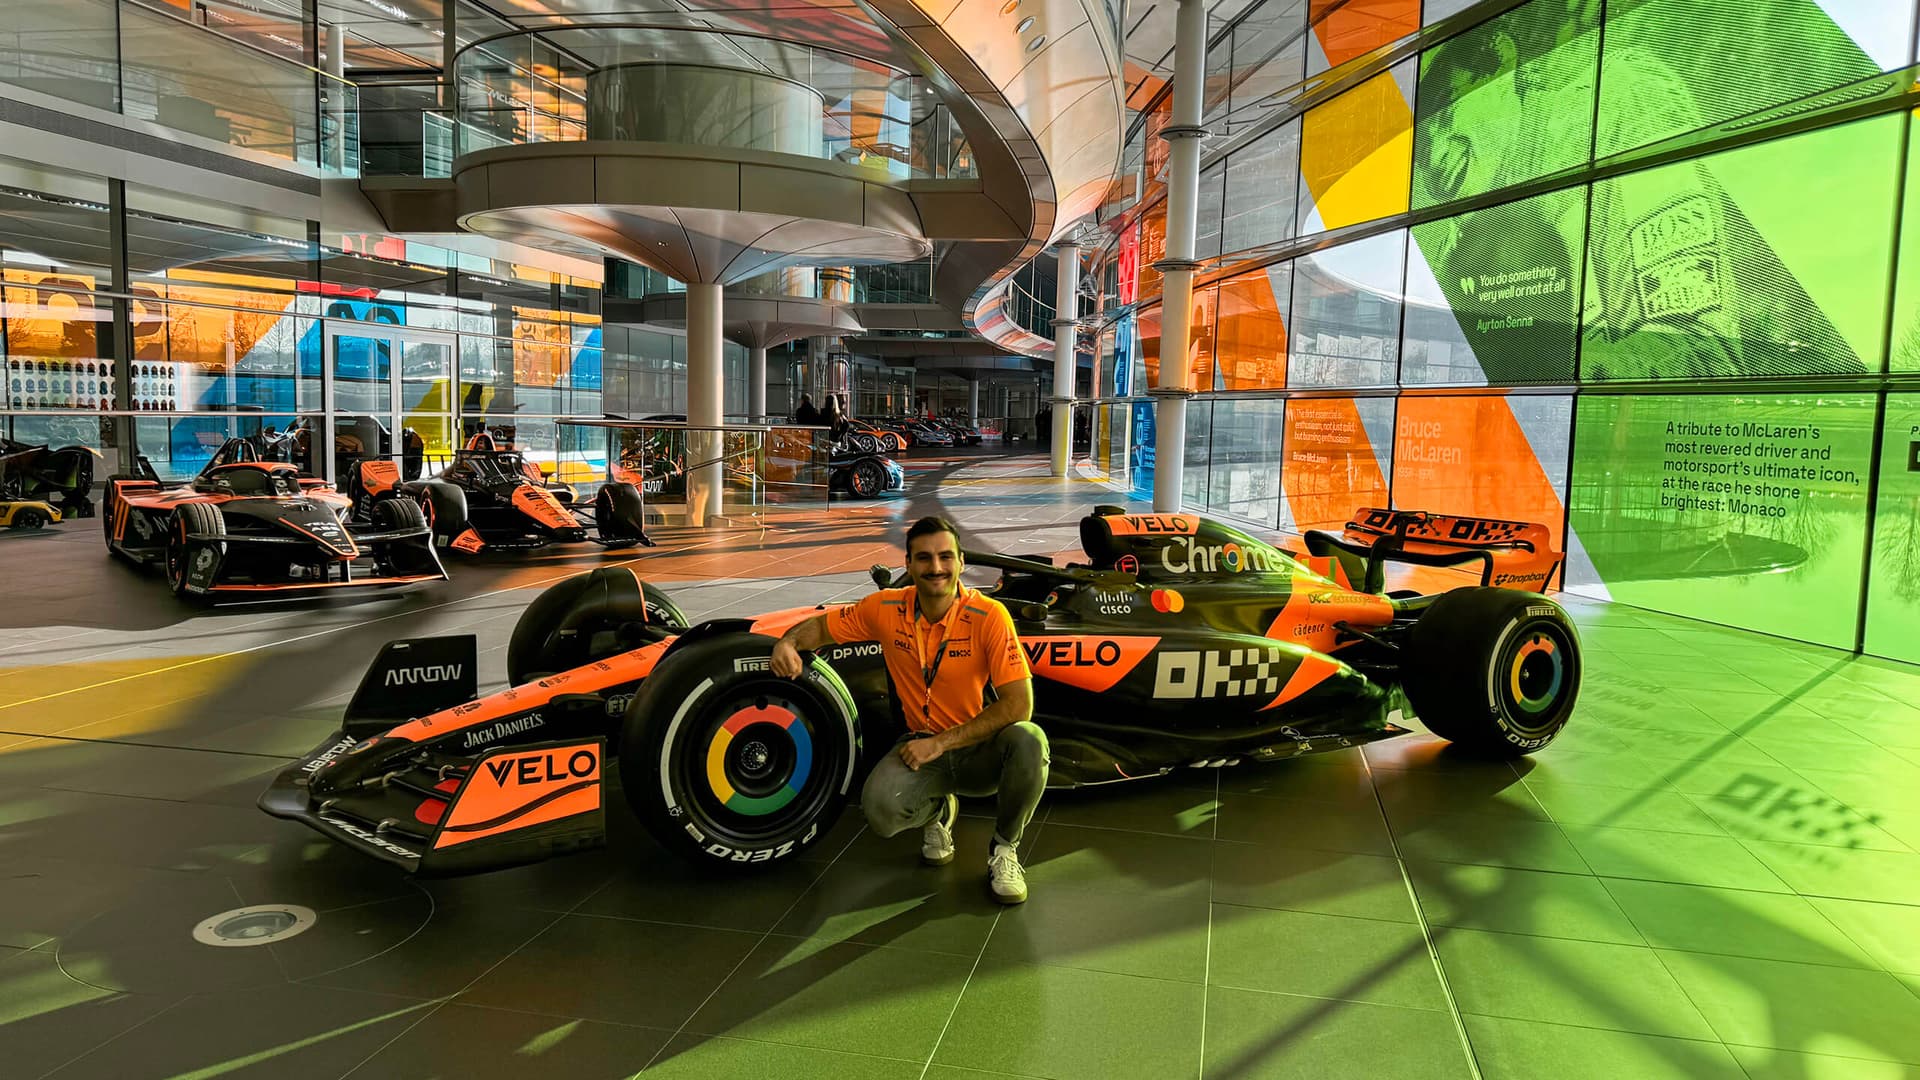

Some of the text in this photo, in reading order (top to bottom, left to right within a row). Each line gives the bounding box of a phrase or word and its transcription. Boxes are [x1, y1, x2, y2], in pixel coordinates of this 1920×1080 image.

[1480, 266, 1557, 287] You do something
[1479, 279, 1566, 303] very well or not at all
[1477, 315, 1534, 333] Ayrton Senna
[1400, 415, 1441, 439] Bruce
[1666, 421, 1675, 435] A
[1677, 423, 1722, 437] tribute
[1725, 424, 1740, 437] to
[1398, 439, 1461, 465] McLaren
[1665, 441, 1831, 460] most revered driver and
[1753, 462, 1816, 481] ultimate
[1819, 465, 1860, 486] icon,
[1662, 476, 1801, 499] at the race he shone
[1661, 493, 1786, 518] brightest: Monaco
[1123, 516, 1189, 533] VELO
[1449, 519, 1528, 541] OKX
[1162, 536, 1285, 574] Chrome
[1507, 572, 1546, 584] Dropbox
[1526, 605, 1555, 617] PIRELLI
[833, 649, 853, 660] DP
[949, 649, 971, 658] OKX
[1022, 641, 1121, 667] VELO
[385, 664, 462, 687] ARROW
[1153, 647, 1280, 699] OKX
[1507, 732, 1552, 749] ZERO
[486, 750, 597, 788] VELO
[320, 816, 422, 859] McLaren
[705, 823, 818, 863] P ZERO
